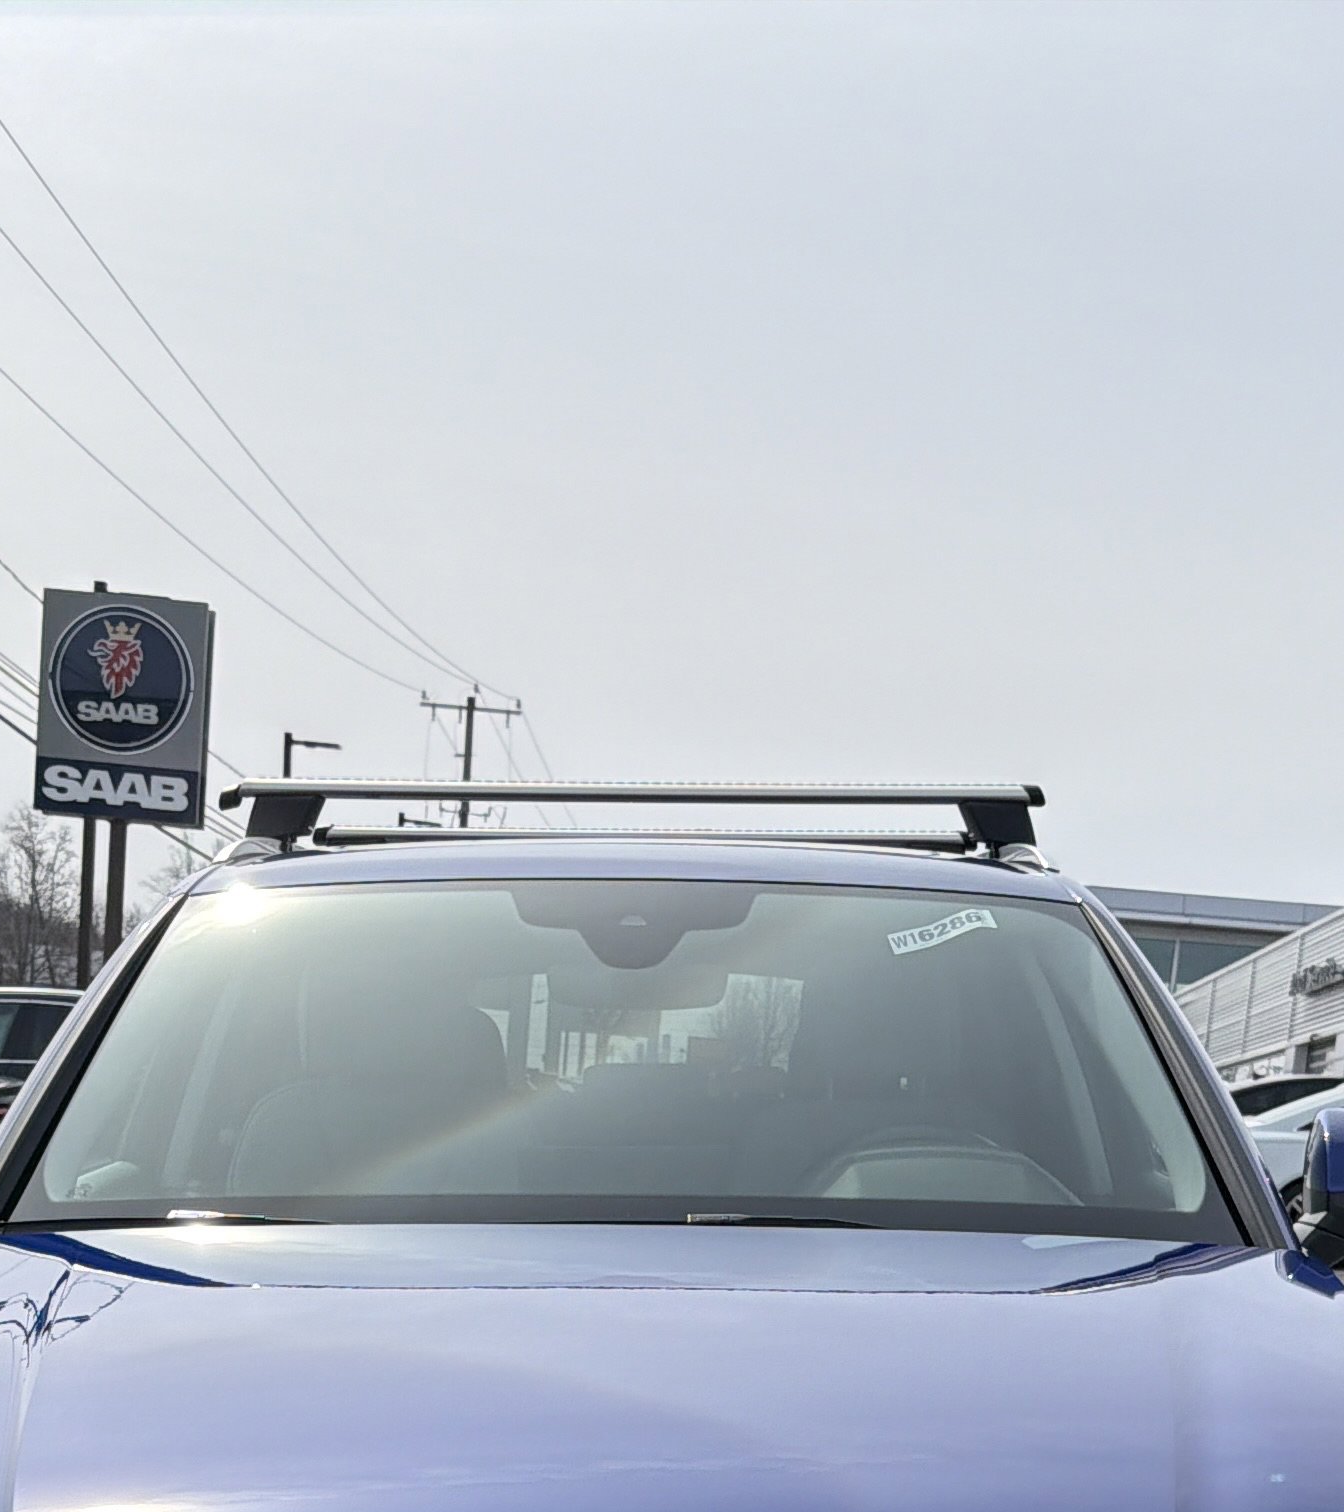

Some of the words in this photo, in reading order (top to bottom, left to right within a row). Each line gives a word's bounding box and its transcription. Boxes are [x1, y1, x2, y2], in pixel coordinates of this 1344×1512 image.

[76, 700, 159, 725] SAAB
[41, 764, 189, 812] SAAB
[891, 911, 982, 949] W16286
